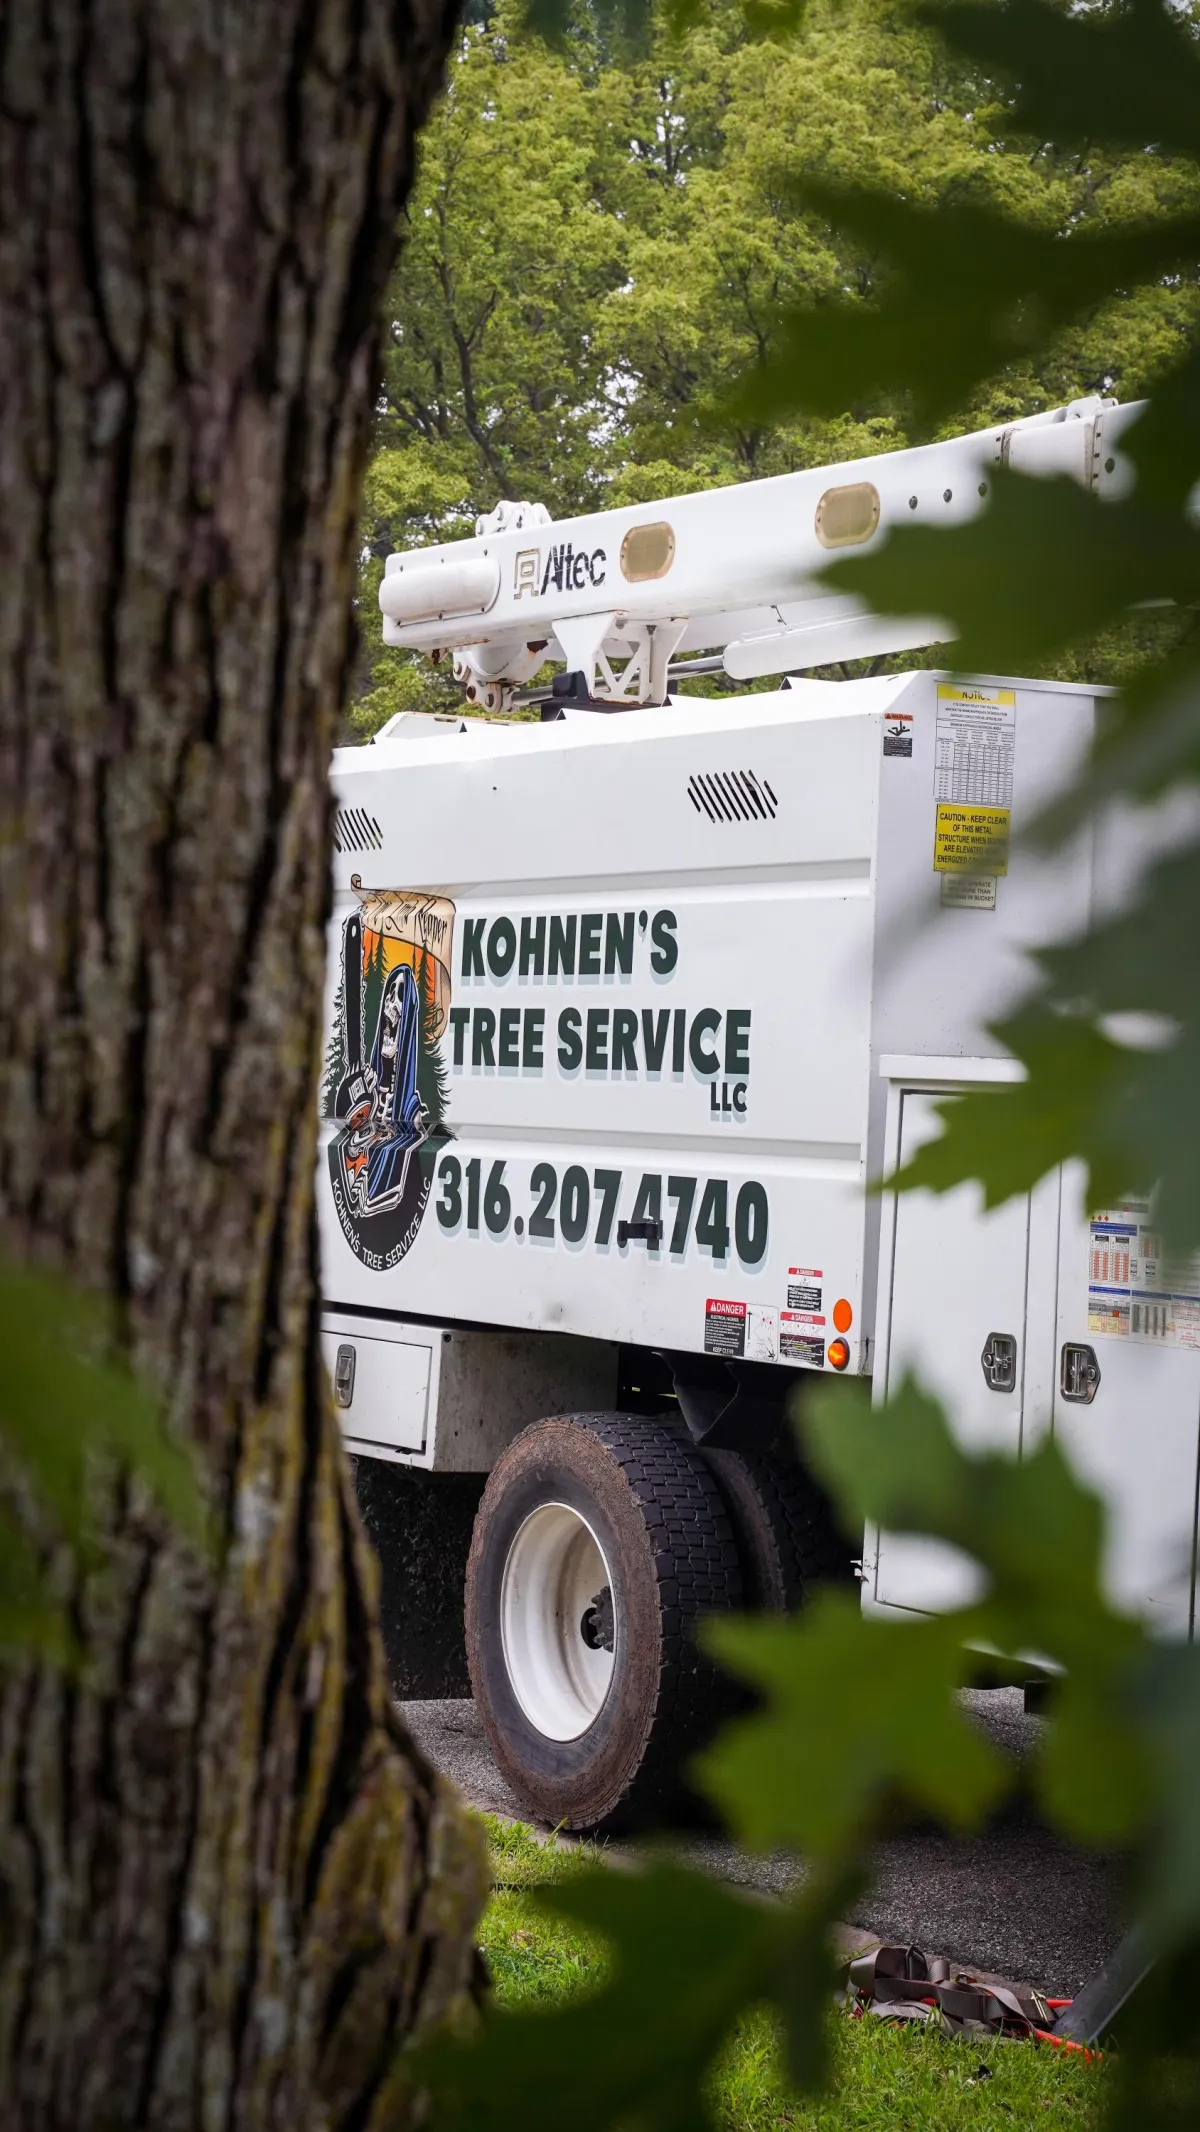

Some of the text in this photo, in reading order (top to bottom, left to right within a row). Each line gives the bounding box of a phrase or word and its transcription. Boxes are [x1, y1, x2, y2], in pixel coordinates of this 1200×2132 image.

[540, 542, 607, 595] Altec
[939, 812, 966, 822] CAUTION
[970, 815, 986, 824] KEEP
[987, 816, 1007, 825] CLEAR
[952, 823, 993, 834] OF THIS METAL
[938, 833, 970, 843] STRUCTURE
[970, 836, 986, 845] WHEN
[943, 844, 955, 853] ARE
[956, 845, 983, 855] ELEVATED
[937, 855, 968, 864] ENERGIZED
[461, 909, 679, 980] KOHNEN'S
[449, 1007, 751, 1075] TREE SERVICE
[710, 1082, 748, 1113] LLC
[436, 1155, 768, 1264] 316.207.4740
[332, 1177, 431, 1269] KOHNEN'S TREE SERVICE LLC
[716, 1302, 744, 1315] DANGER
